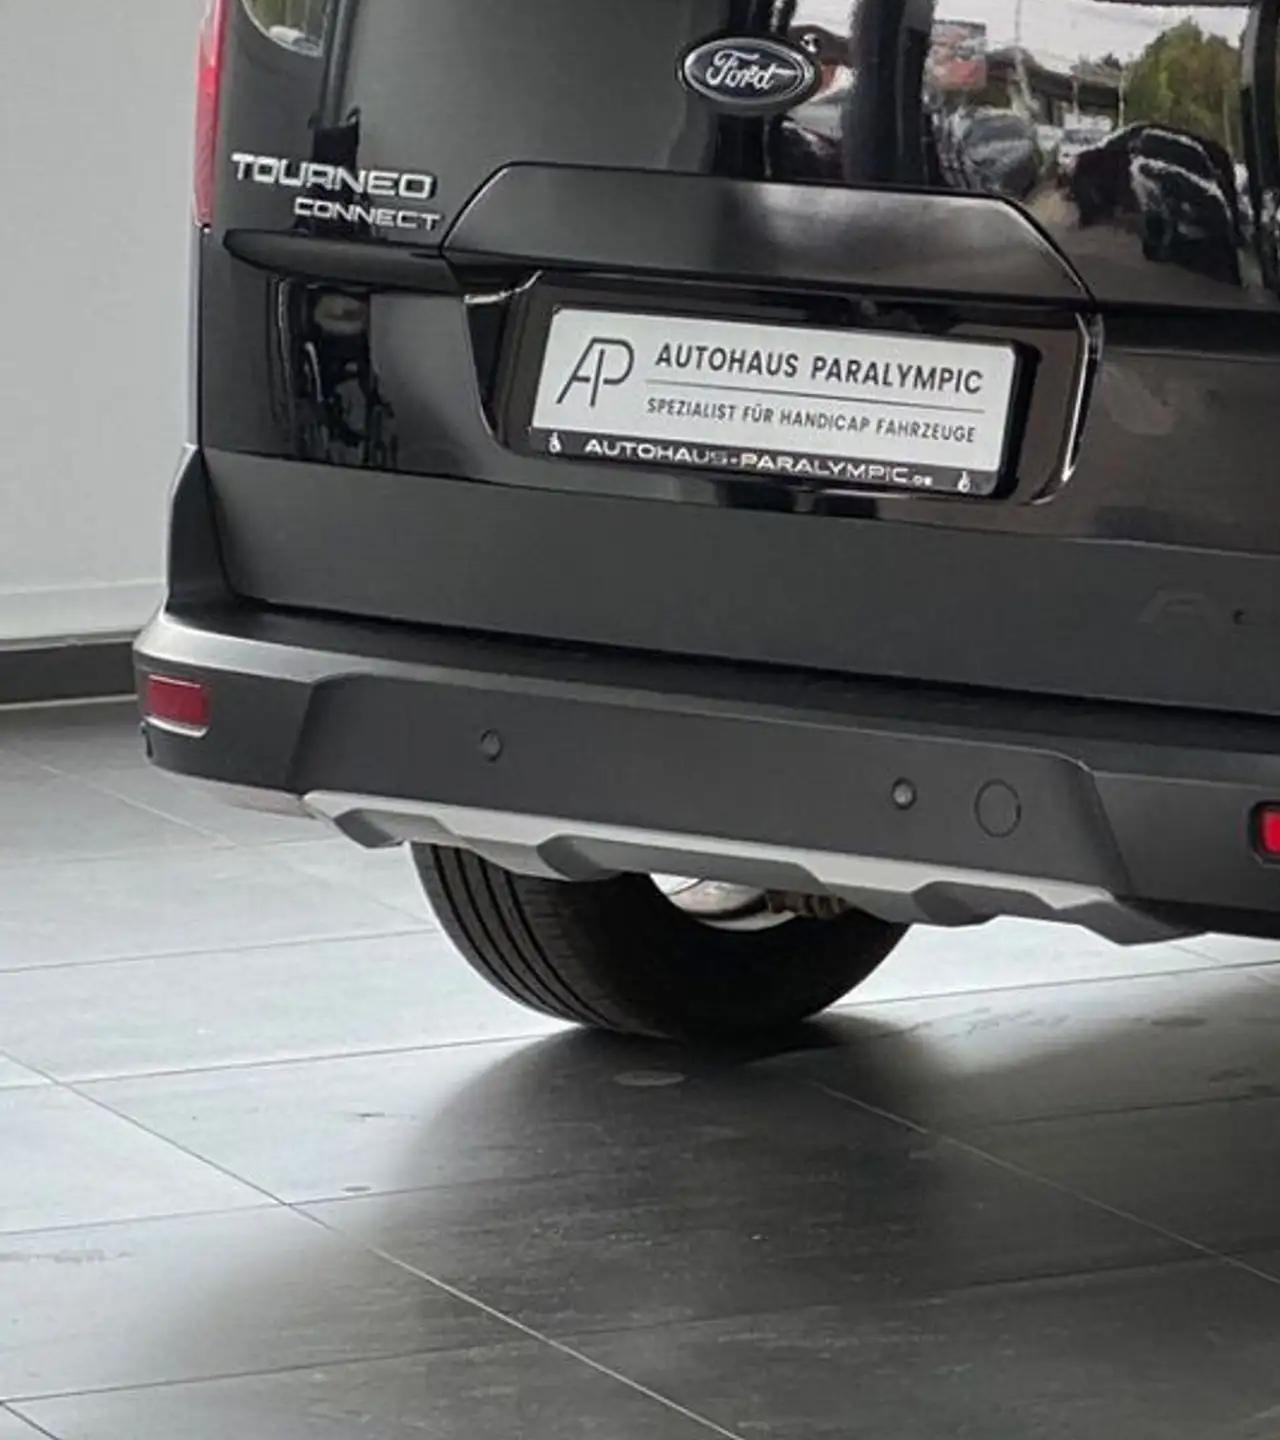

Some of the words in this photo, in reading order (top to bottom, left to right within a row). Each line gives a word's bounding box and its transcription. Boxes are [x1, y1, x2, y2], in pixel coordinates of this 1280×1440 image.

[704, 48, 785, 92] Ford
[231, 153, 438, 200] TOURNEO
[293, 197, 442, 231] CONNECT
[654, 341, 799, 379] AUTOHAUS
[809, 355, 984, 395] PARALYMPIC
[646, 397, 737, 423] SPEZIALIST
[741, 404, 776, 426] FÜR
[779, 408, 871, 434] HANDICAP
[876, 417, 977, 444] FAHRZEUGE
